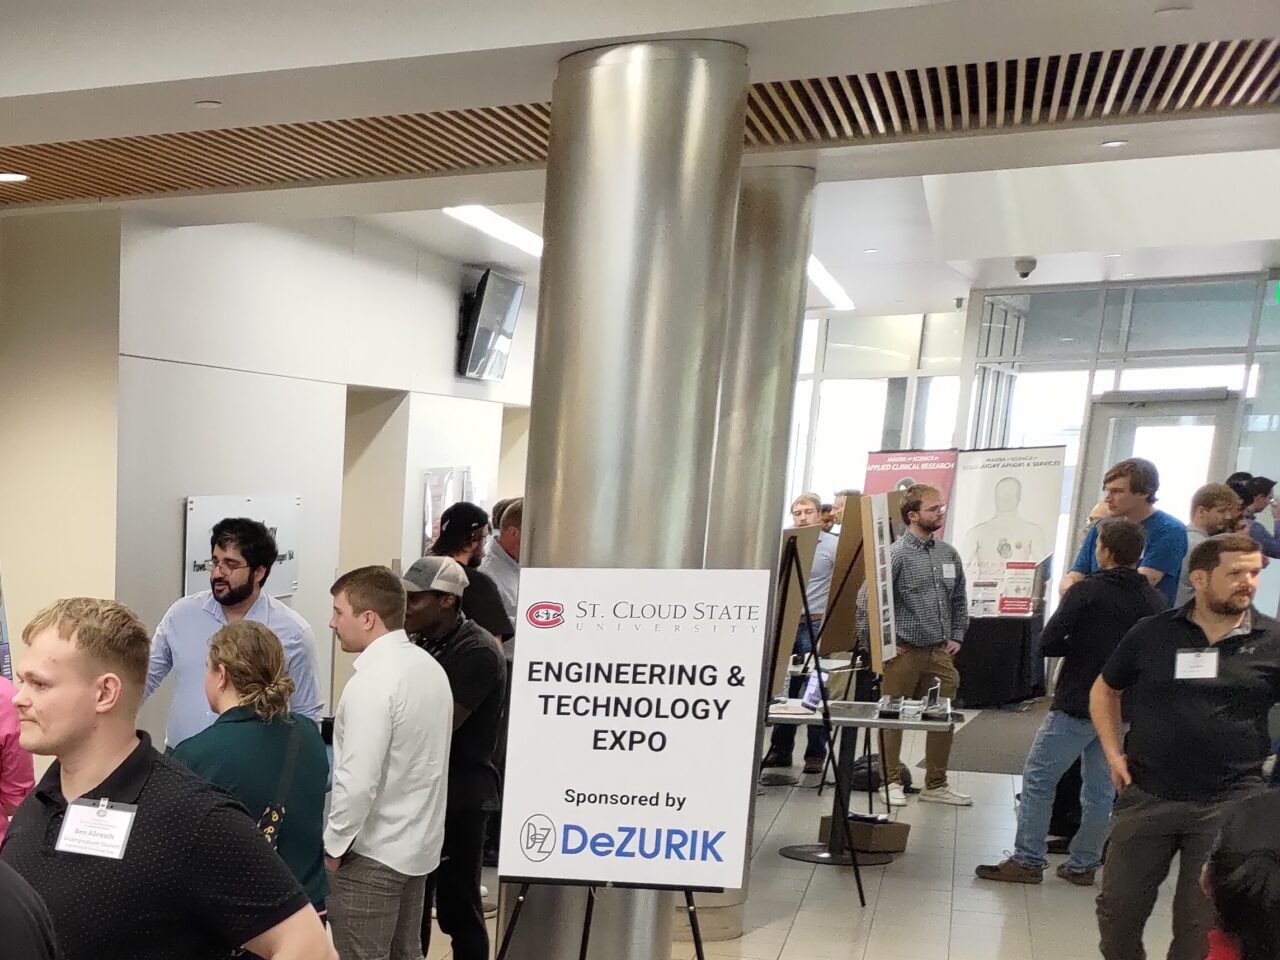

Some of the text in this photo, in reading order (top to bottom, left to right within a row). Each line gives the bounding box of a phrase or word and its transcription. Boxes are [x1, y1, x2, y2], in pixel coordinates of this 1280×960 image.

[921, 462, 955, 470] RESEARCH
[575, 600, 760, 621] ST. CLOUD STATE
[575, 622, 759, 633] UNIVERSITY
[527, 661, 746, 687] ENGINEERING &
[538, 694, 732, 720] TECHNOLOGY
[592, 729, 668, 752] EXPO
[564, 788, 687, 811] Sponsored by
[561, 823, 727, 862] DeZURIK
